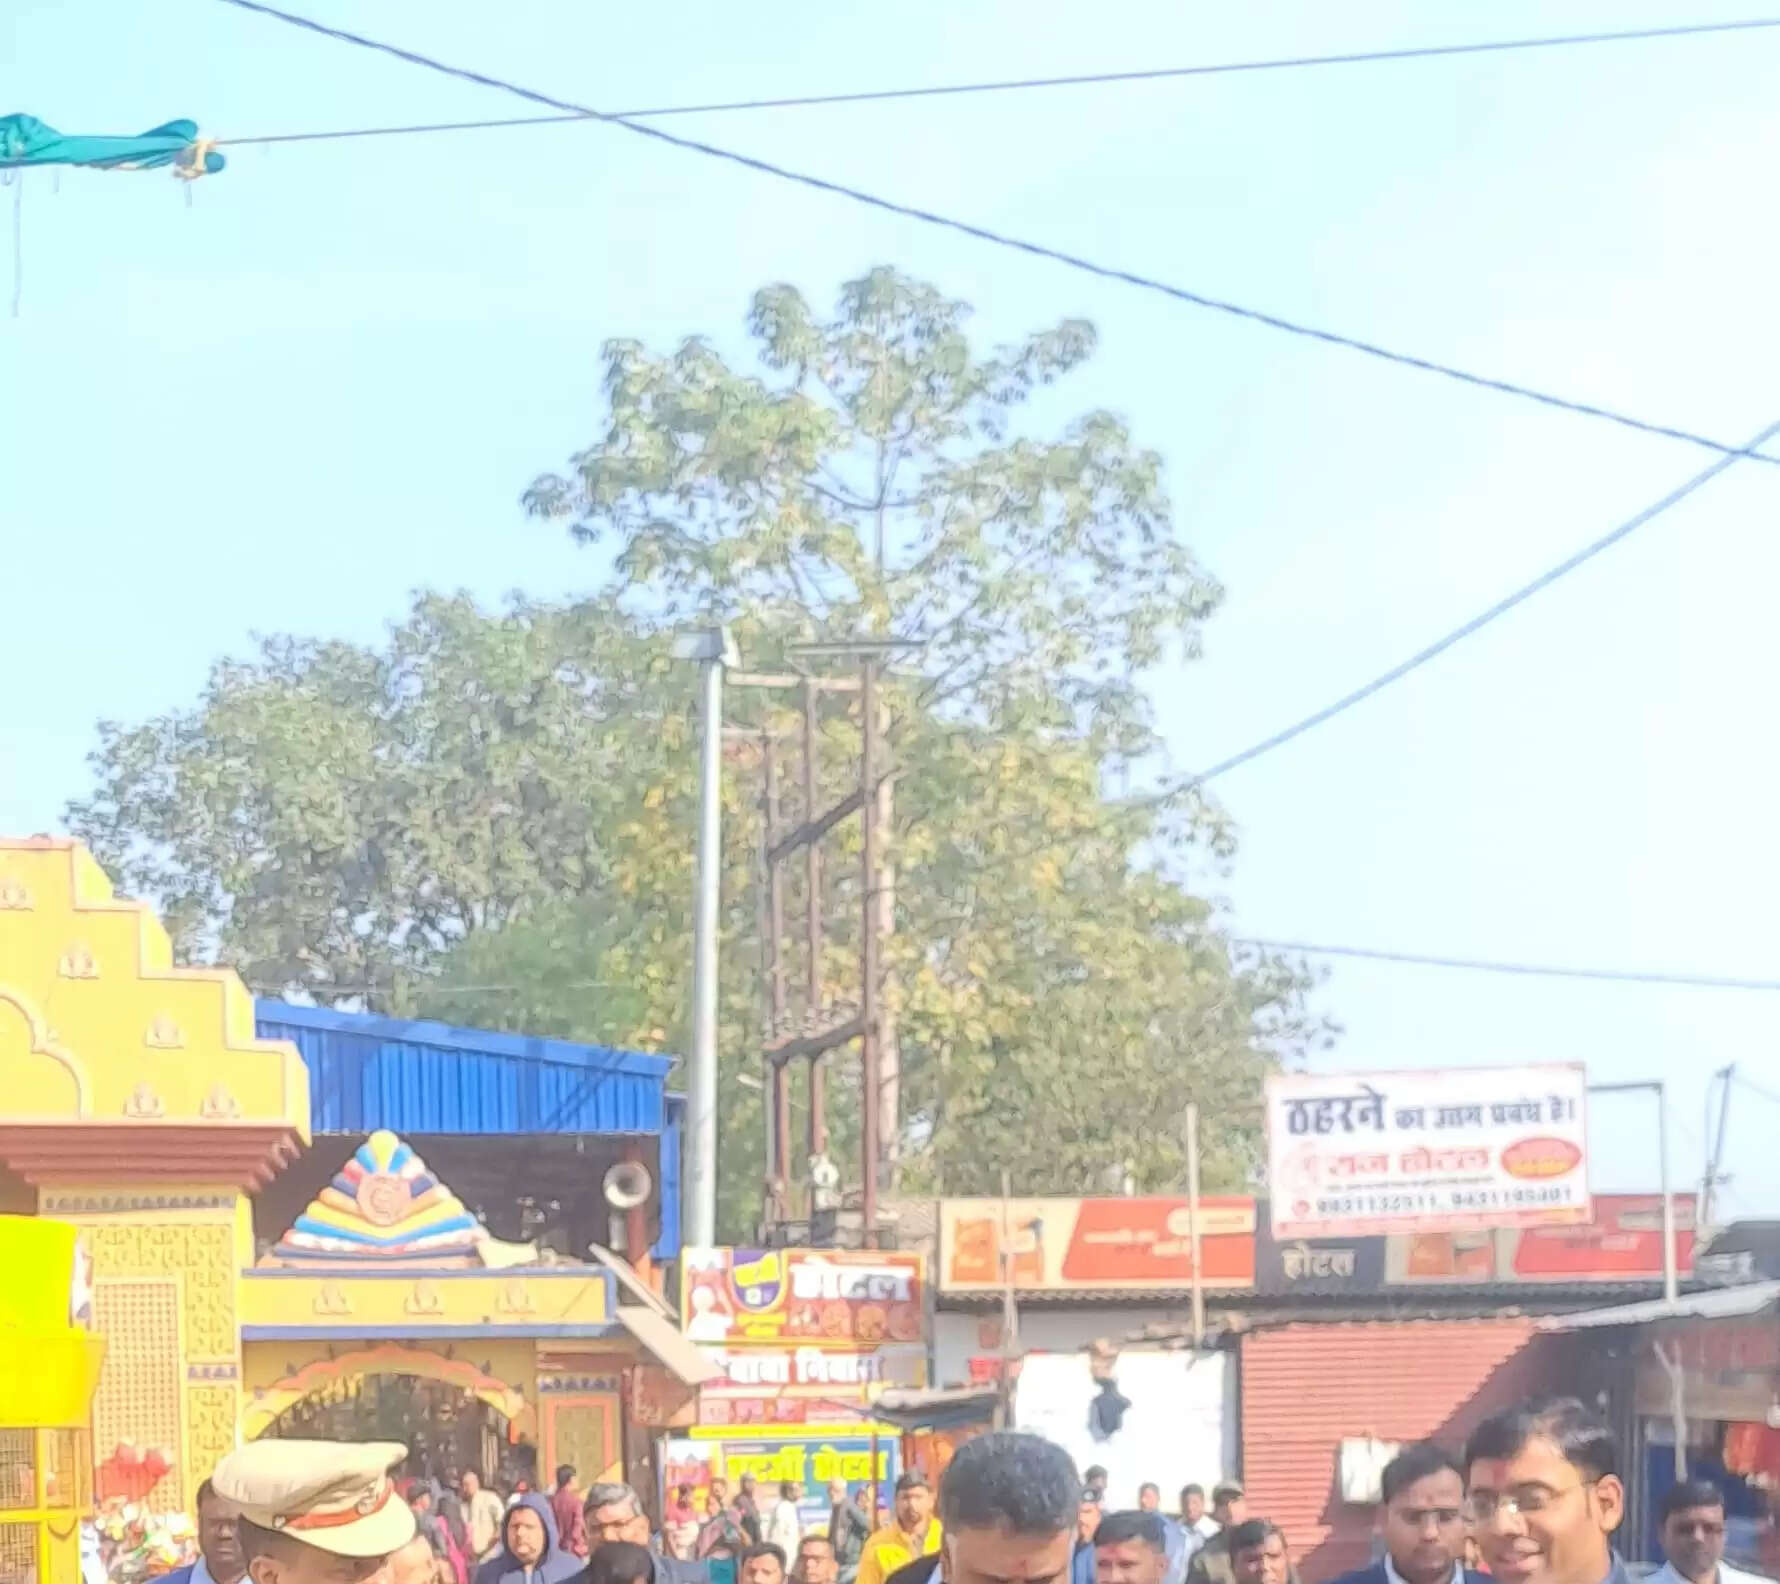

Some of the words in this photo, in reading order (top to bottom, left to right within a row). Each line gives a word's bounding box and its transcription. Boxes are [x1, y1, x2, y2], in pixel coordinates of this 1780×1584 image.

[1283, 1084, 1389, 1135] ठहरने
[1395, 1108, 1425, 1130] का
[1282, 1243, 1357, 1280] होटल
